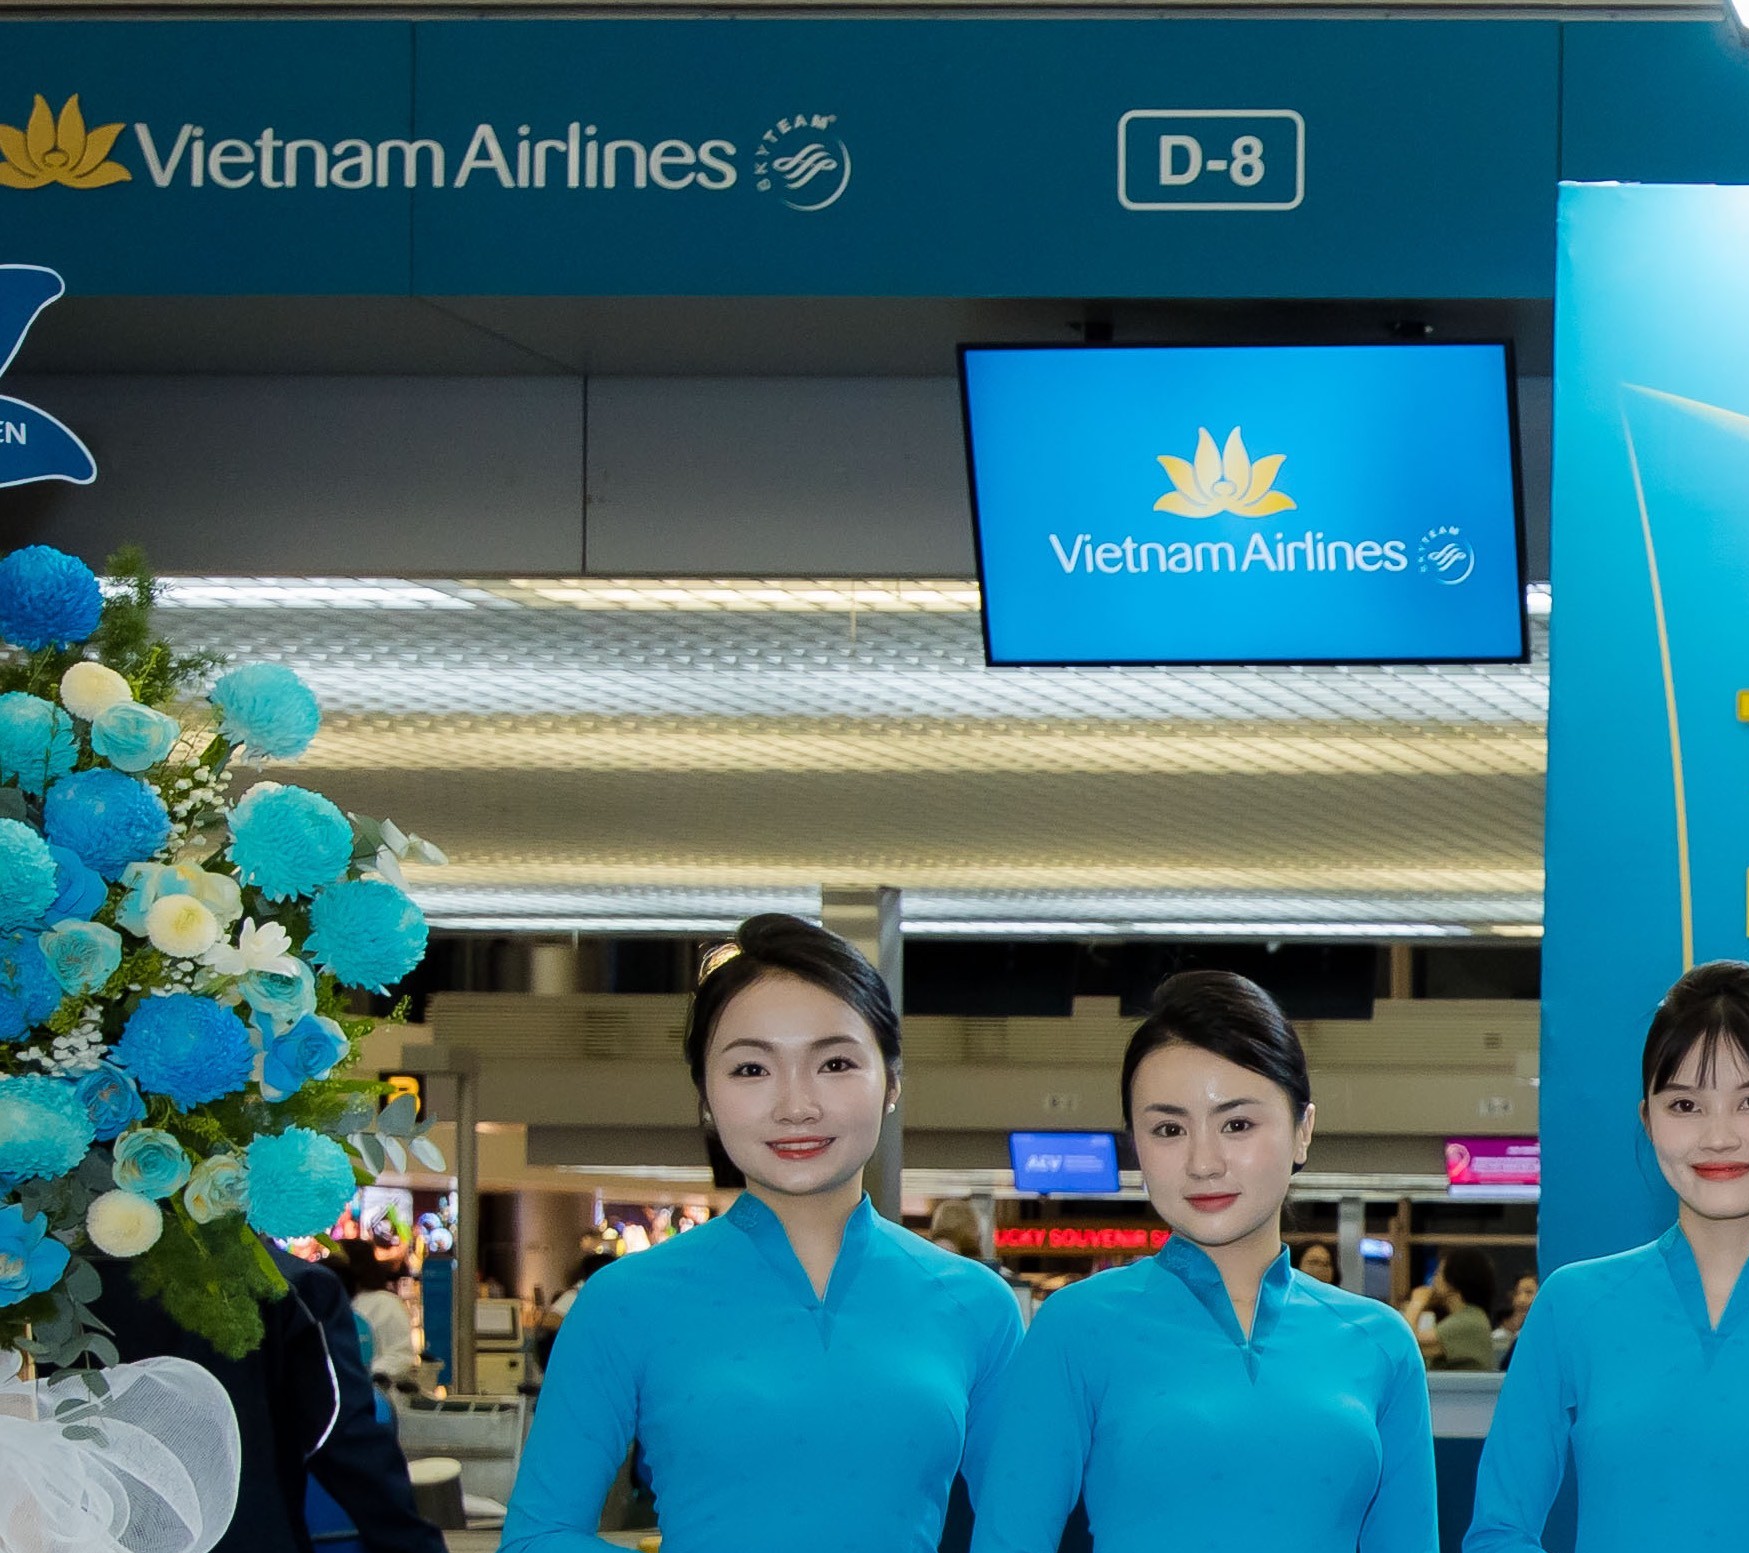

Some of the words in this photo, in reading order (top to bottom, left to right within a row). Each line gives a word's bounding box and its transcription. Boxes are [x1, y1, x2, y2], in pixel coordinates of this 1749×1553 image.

[134, 122, 443, 190] Vietnam
[453, 121, 738, 190] Airlines
[1158, 134, 1266, 187] D-8
[1049, 532, 1236, 574] Vietnam
[1244, 531, 1407, 573] Airlines
[993, 1227, 1046, 1247] UCKY
